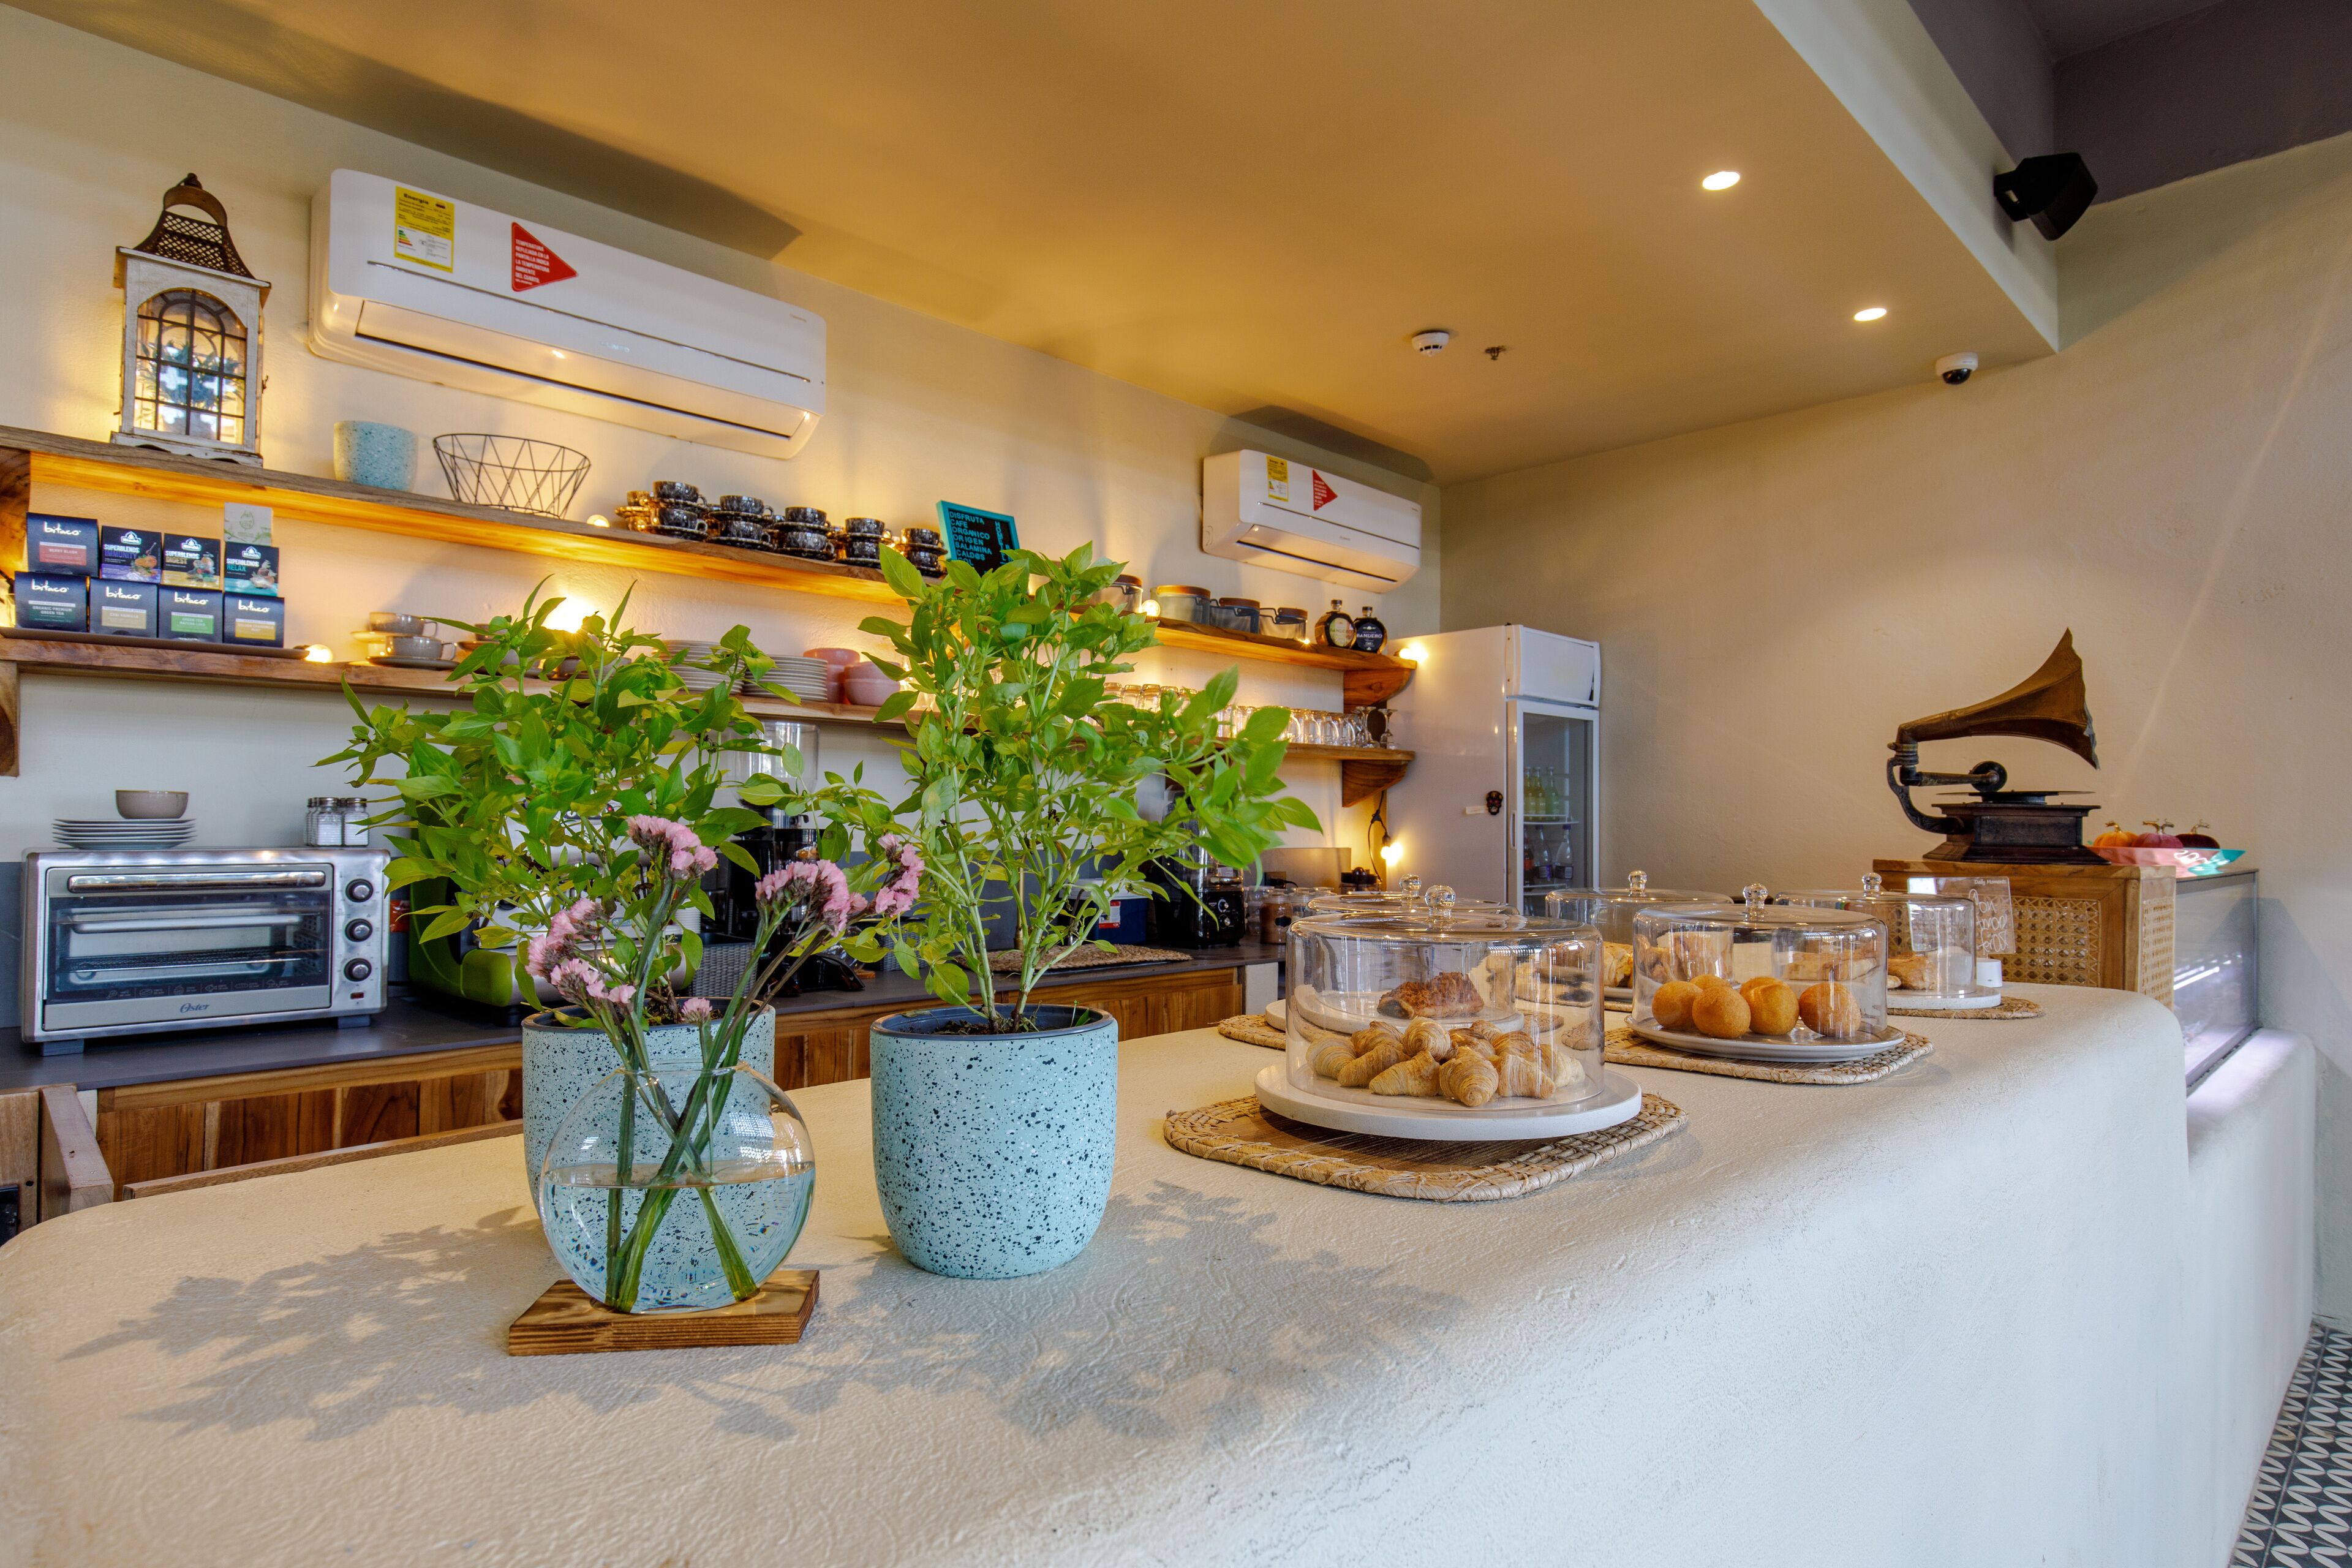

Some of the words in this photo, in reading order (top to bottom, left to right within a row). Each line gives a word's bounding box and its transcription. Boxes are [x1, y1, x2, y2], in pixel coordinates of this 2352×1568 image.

[949, 511, 985, 525] DISFRUTA
[951, 519, 968, 528] CAFE
[43, 521, 81, 536] bitaco
[952, 527, 990, 540] ORGANICO
[953, 534, 984, 546] ORIGEN
[104, 544, 140, 554] SUPERBLENDS
[955, 541, 992, 555] SALAMINA
[165, 550, 200, 560] SUPERBLENDS
[226, 558, 260, 567] SUPERBLENDS
[31, 579, 69, 594] bitaco
[106, 586, 141, 600] bitaco
[174, 591, 209, 605] bitaco
[238, 598, 270, 613] bitaco
[179, 1003, 210, 1013] Oster
